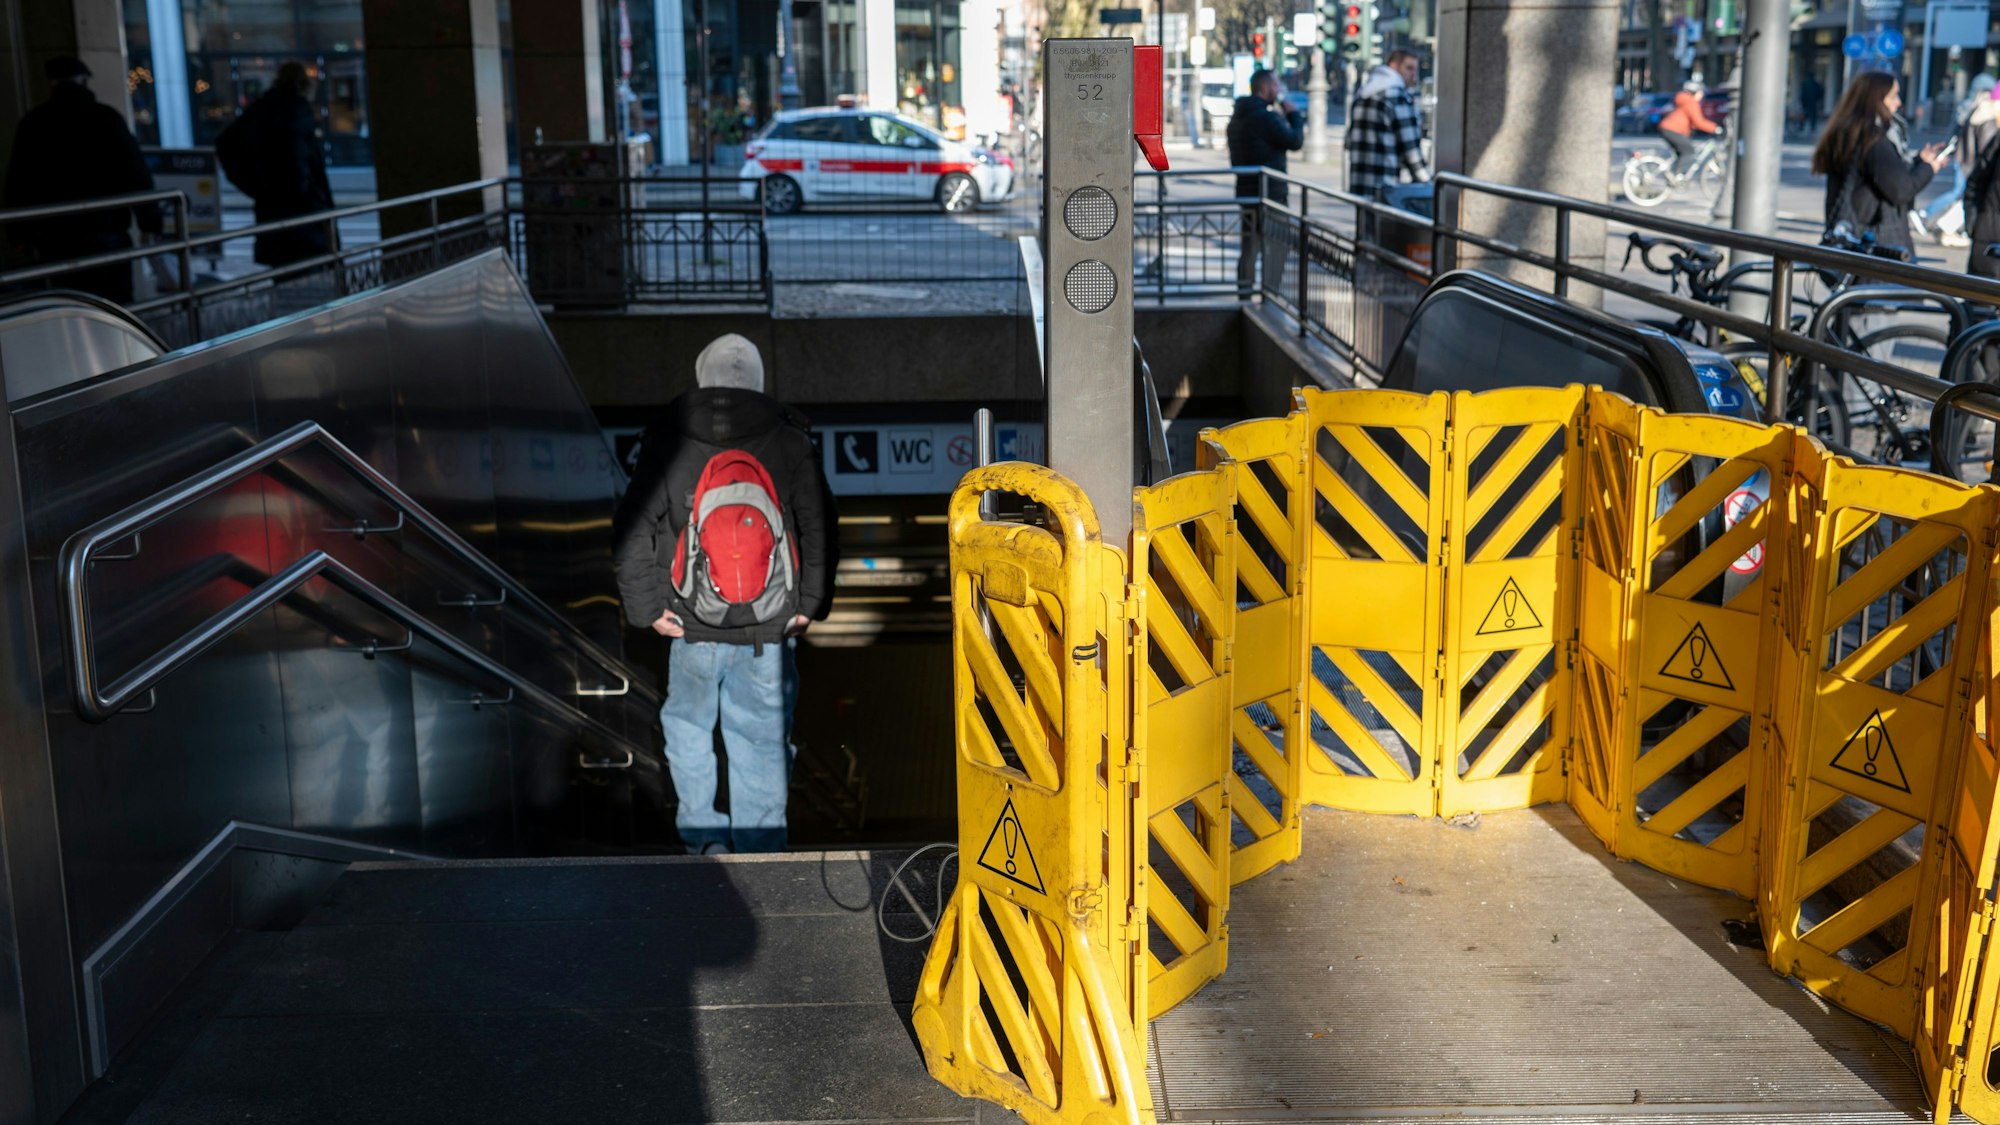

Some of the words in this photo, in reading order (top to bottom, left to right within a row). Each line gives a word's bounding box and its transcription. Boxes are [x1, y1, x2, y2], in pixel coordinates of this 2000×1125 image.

[1064, 72, 1117, 80] thyssenkrupp
[1077, 84, 1103, 101] 52
[891, 439, 932, 464] WC
